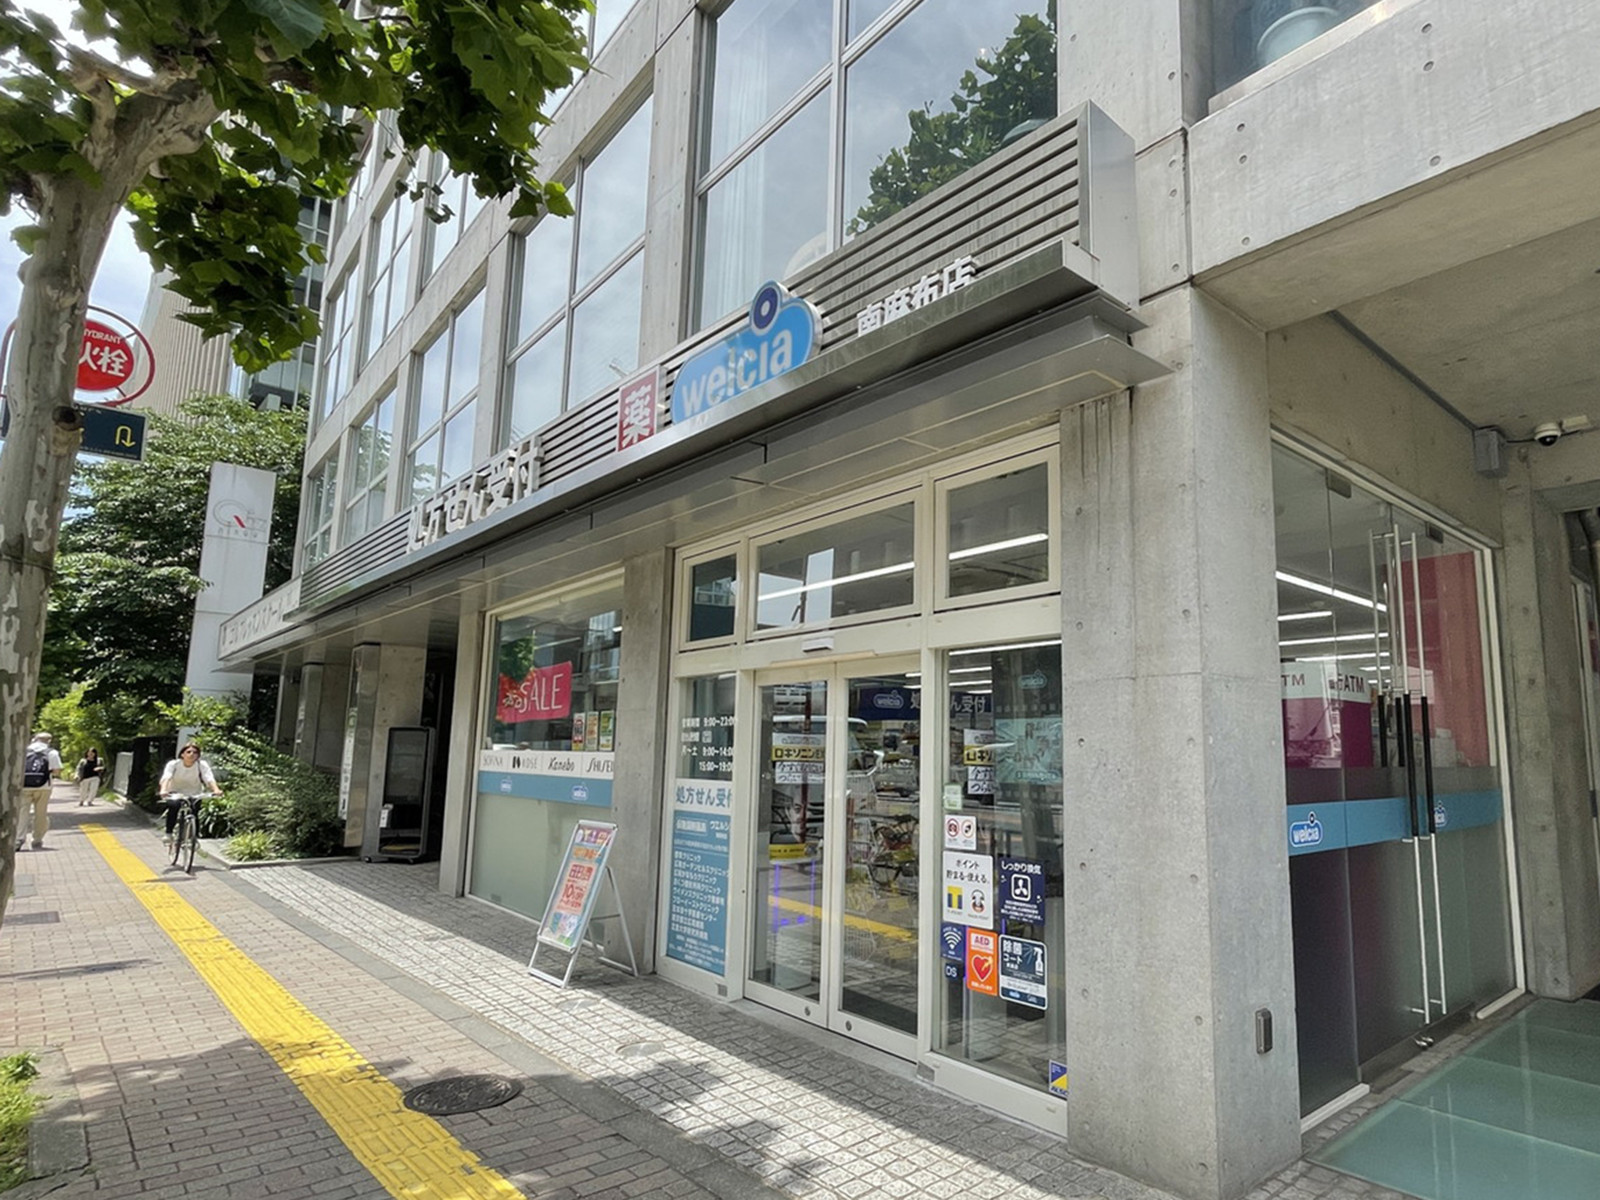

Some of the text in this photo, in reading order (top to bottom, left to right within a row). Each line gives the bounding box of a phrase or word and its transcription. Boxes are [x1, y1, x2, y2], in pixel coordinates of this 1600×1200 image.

[682, 329, 793, 418] welcia
[622, 384, 651, 449] 薬
[519, 673, 564, 714] SALE
[974, 936, 991, 946] AED
